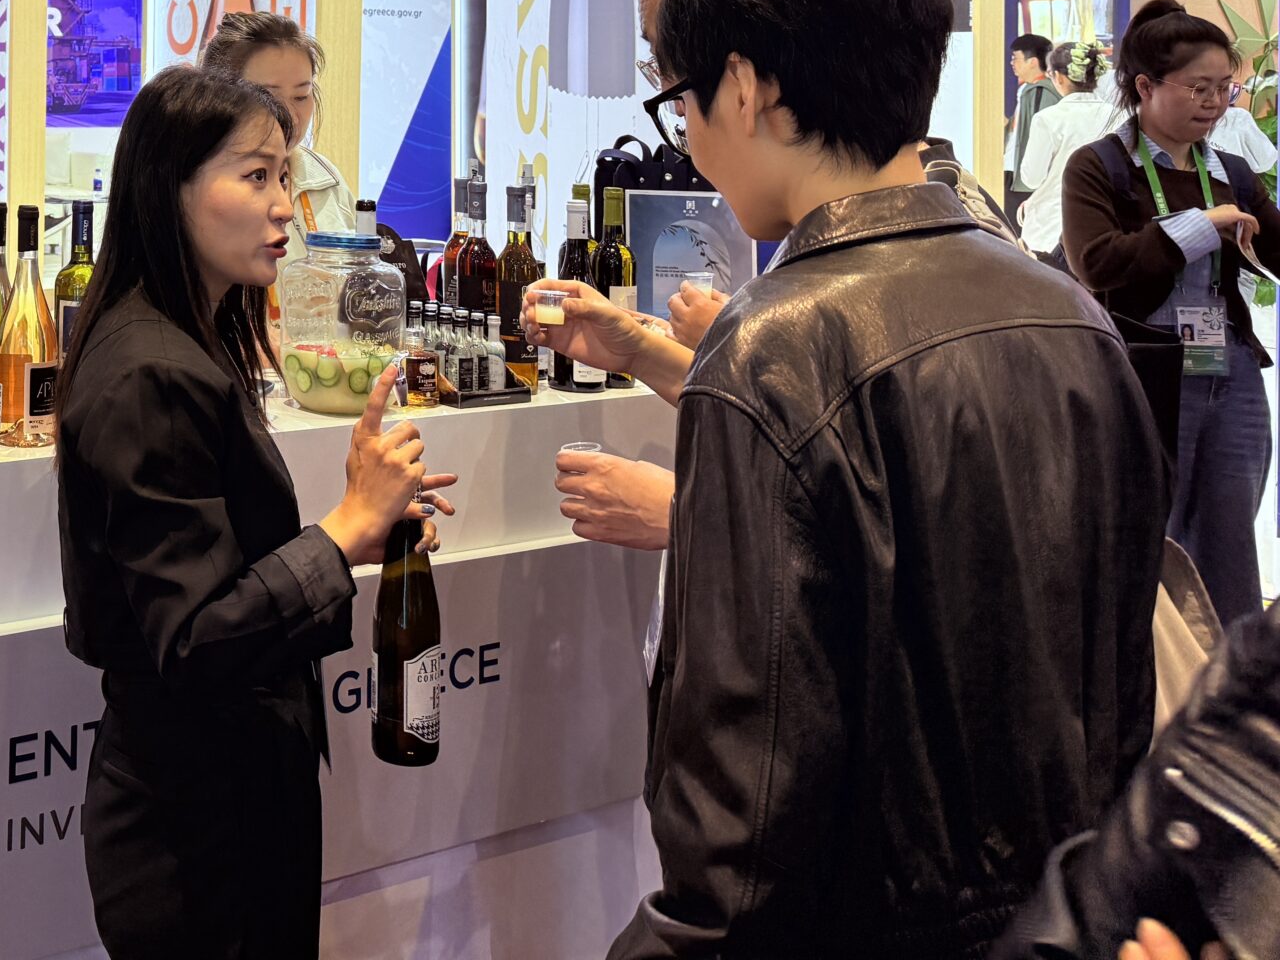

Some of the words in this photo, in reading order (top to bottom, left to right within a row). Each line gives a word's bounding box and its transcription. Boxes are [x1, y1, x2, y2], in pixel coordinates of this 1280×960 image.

[363, 8, 422, 19] egreece.gov.gr
[332, 642, 501, 714] GCE
[417, 658, 439, 675] AR
[6, 803, 86, 852] INV
